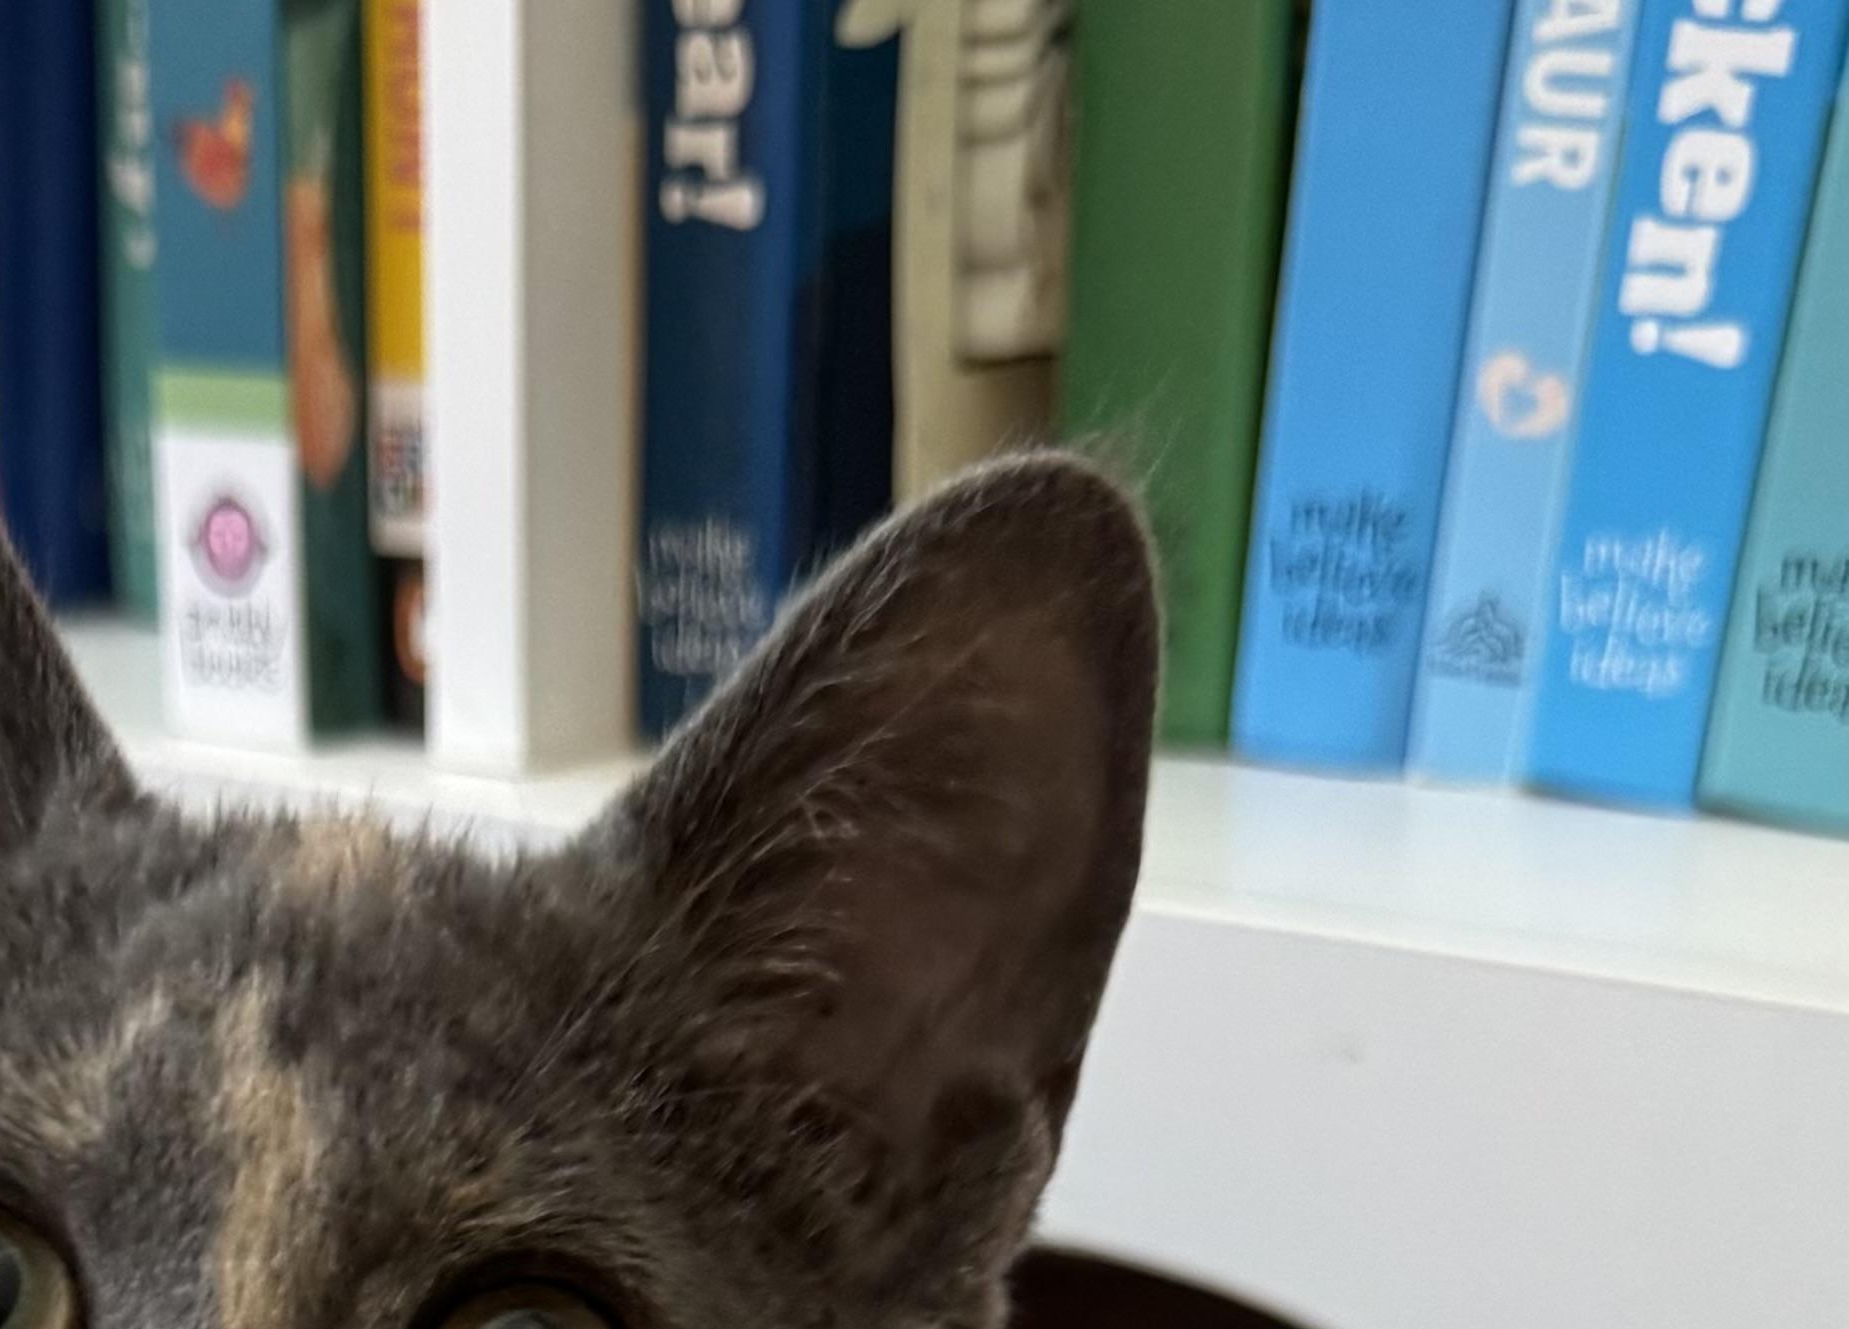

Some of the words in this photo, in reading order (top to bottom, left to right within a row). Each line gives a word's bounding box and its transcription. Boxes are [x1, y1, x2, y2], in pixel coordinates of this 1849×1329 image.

[658, 0, 766, 231] ar!
[1617, 0, 1796, 370] ken!
[1583, 528, 1705, 588] make
[1559, 572, 1712, 648] believe
[1569, 640, 1686, 695] ideas
